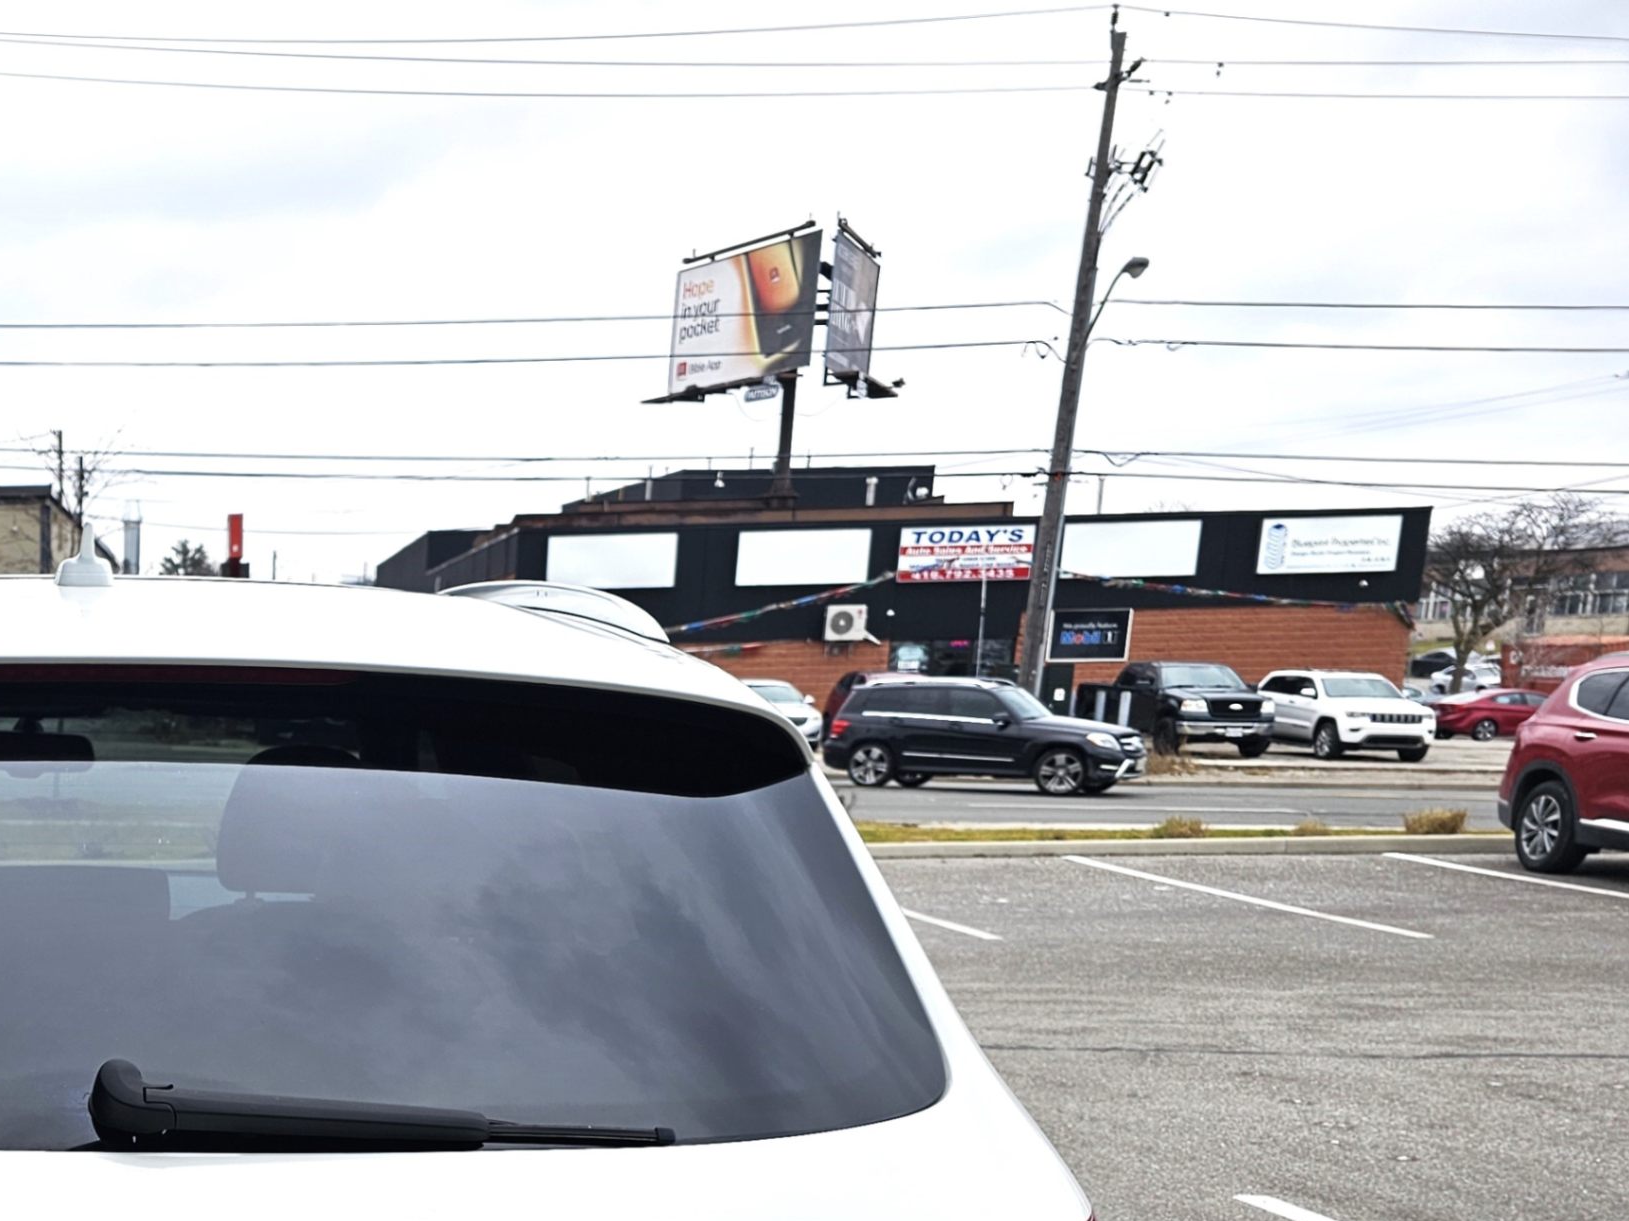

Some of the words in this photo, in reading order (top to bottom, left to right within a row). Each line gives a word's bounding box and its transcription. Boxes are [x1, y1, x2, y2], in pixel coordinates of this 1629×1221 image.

[682, 278, 714, 300] Hope
[681, 303, 692, 321] in
[692, 299, 720, 322] your
[679, 317, 720, 344] pocket
[912, 529, 1024, 544] TODAY'S
[905, 547, 931, 556] Auto
[934, 546, 963, 555] Sales
[987, 545, 1028, 553] Service
[1060, 630, 1101, 645] Mobil
